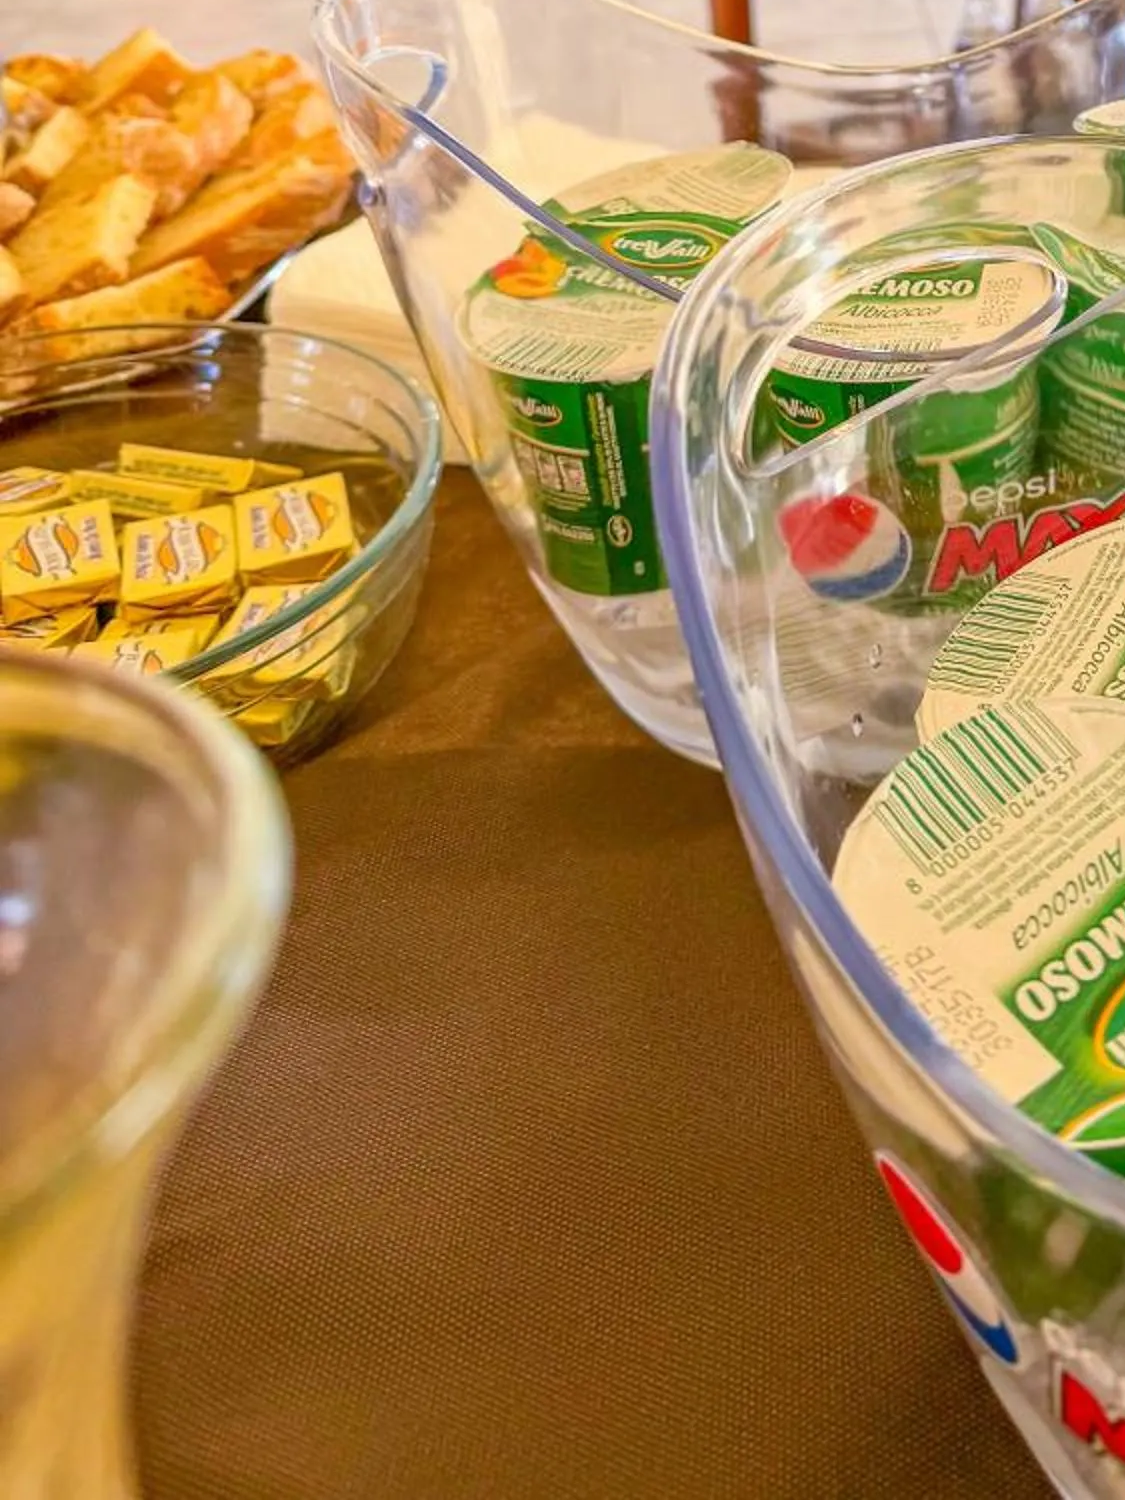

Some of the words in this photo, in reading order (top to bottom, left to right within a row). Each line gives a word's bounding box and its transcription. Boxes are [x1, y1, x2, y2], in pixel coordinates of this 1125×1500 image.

[930, 816, 1006, 878] 000005
[1012, 756, 1079, 819] 044537
[1011, 837, 1124, 951] Albicocca
